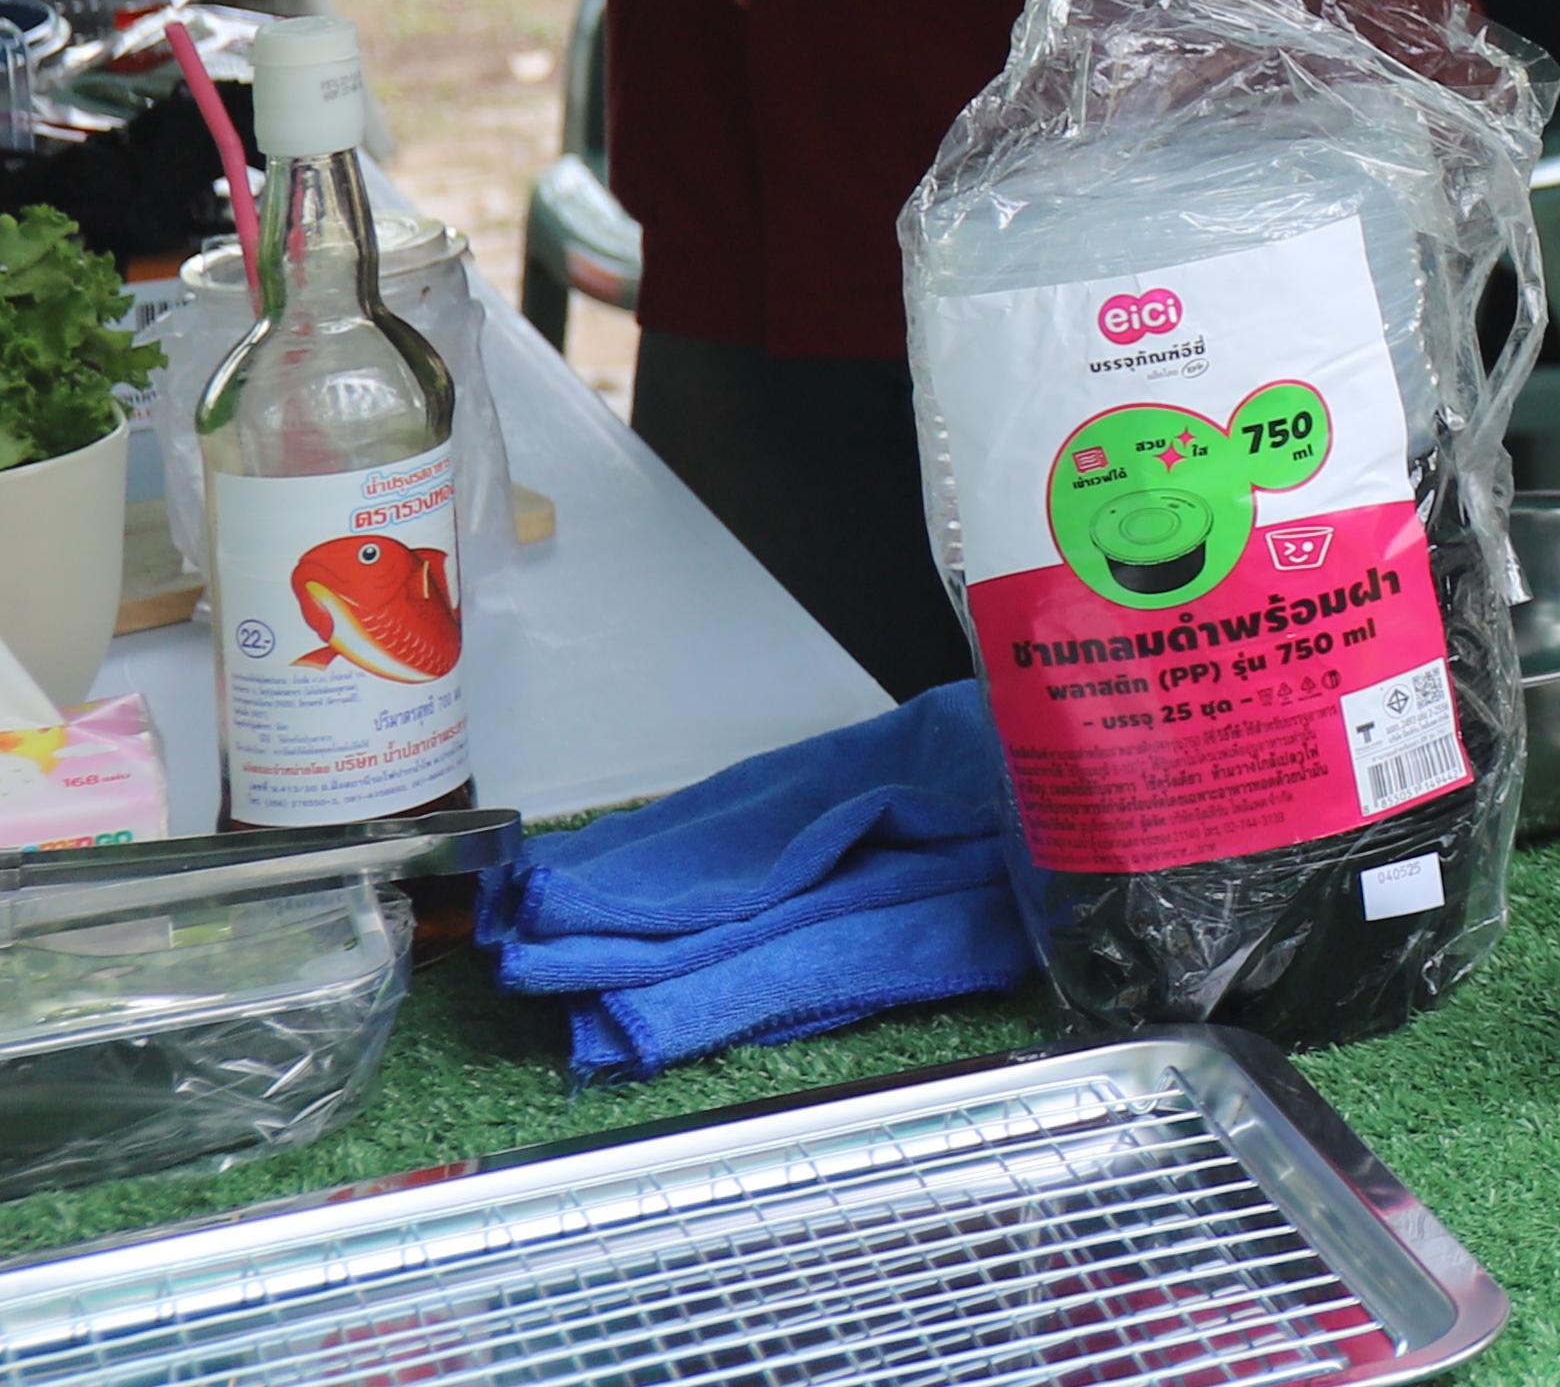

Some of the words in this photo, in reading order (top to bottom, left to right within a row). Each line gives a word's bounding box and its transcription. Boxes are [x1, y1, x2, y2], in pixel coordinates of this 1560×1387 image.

[1089, 335, 1206, 373] บรรจุภัณฑ์อีซี่
[1241, 411, 1312, 455] 750
[1135, 439, 1166, 452] สวย
[1292, 445, 1313, 461] ml
[1073, 467, 1127, 490] เข้าเวฟได้
[1012, 567, 1401, 669] ชามกลมดำพร้อมฝา
[1047, 674, 1149, 701] พลาสติก
[1158, 662, 1221, 692] (PP)
[1232, 651, 1266, 682] รุ่น
[1276, 633, 1334, 665] 750
[1343, 618, 1376, 647] ml
[1102, 711, 1153, 731] บรรจุ
[1161, 702, 1192, 723] 25
[1200, 698, 1233, 723] ชุด
[335, 751, 378, 773] บริษัท
[64, 775, 99, 788] 168
[1377, 861, 1421, 884] 040525
